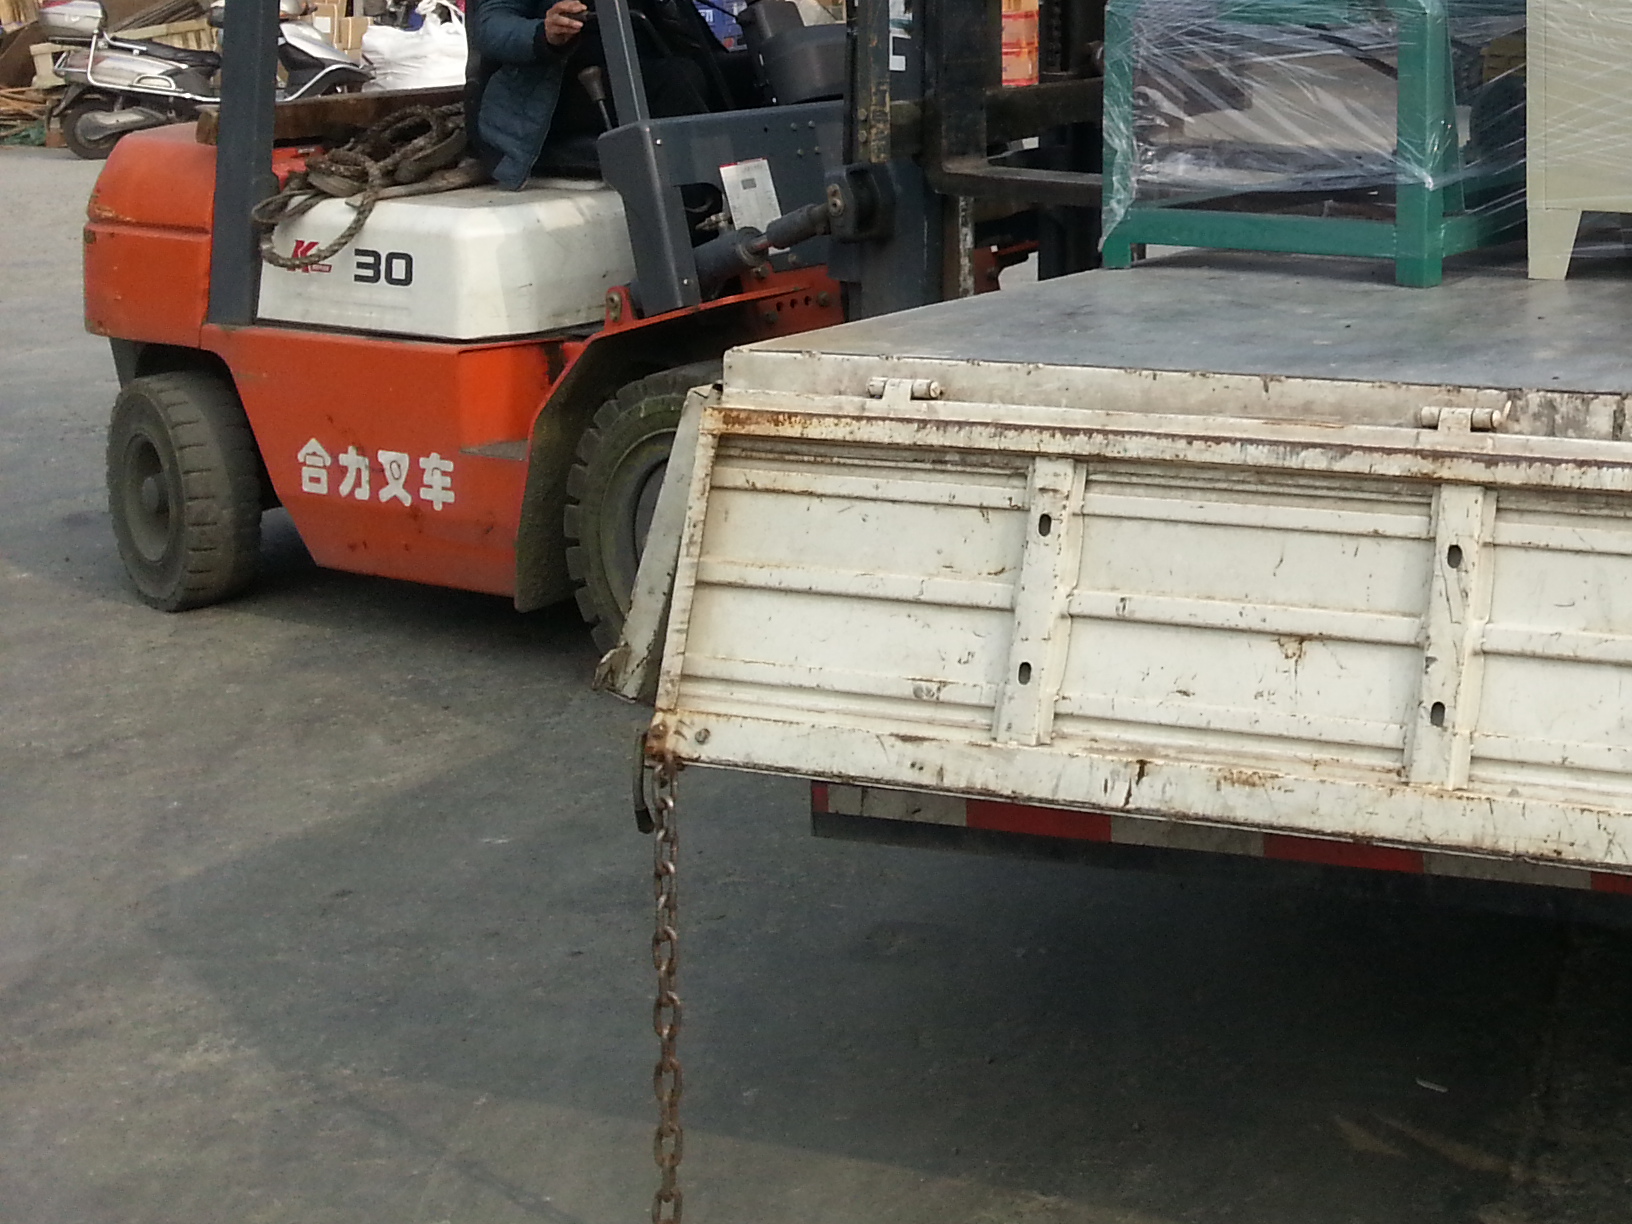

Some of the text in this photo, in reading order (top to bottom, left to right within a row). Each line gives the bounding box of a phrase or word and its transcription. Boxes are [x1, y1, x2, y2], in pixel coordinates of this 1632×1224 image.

[354, 248, 413, 287] 30
[298, 438, 455, 511] 合力叉车
